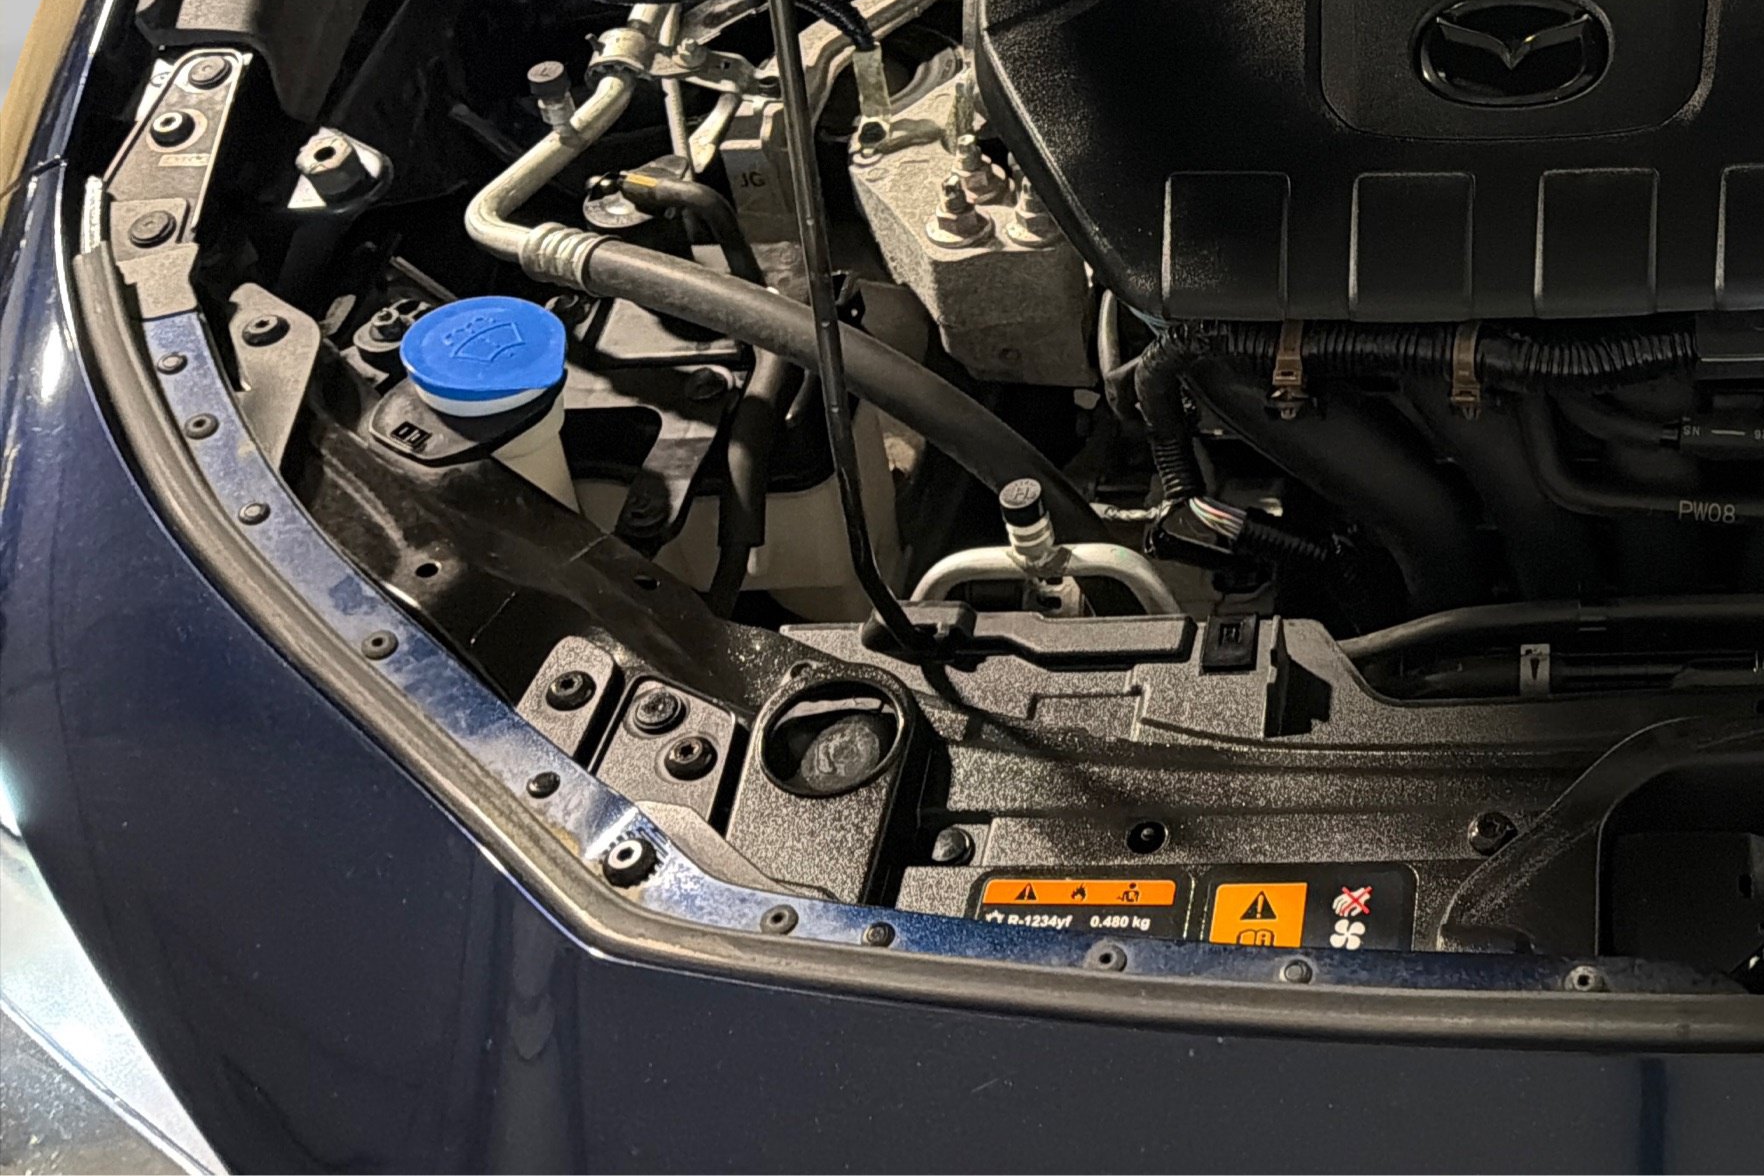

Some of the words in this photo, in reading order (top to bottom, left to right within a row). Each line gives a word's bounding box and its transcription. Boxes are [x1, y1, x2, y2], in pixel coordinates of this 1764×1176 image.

[1678, 499, 1736, 524] PW08
[1007, 914, 1073, 930] R-1234yf
[1089, 915, 1129, 928] 0.480
[1131, 916, 1151, 931] kg
